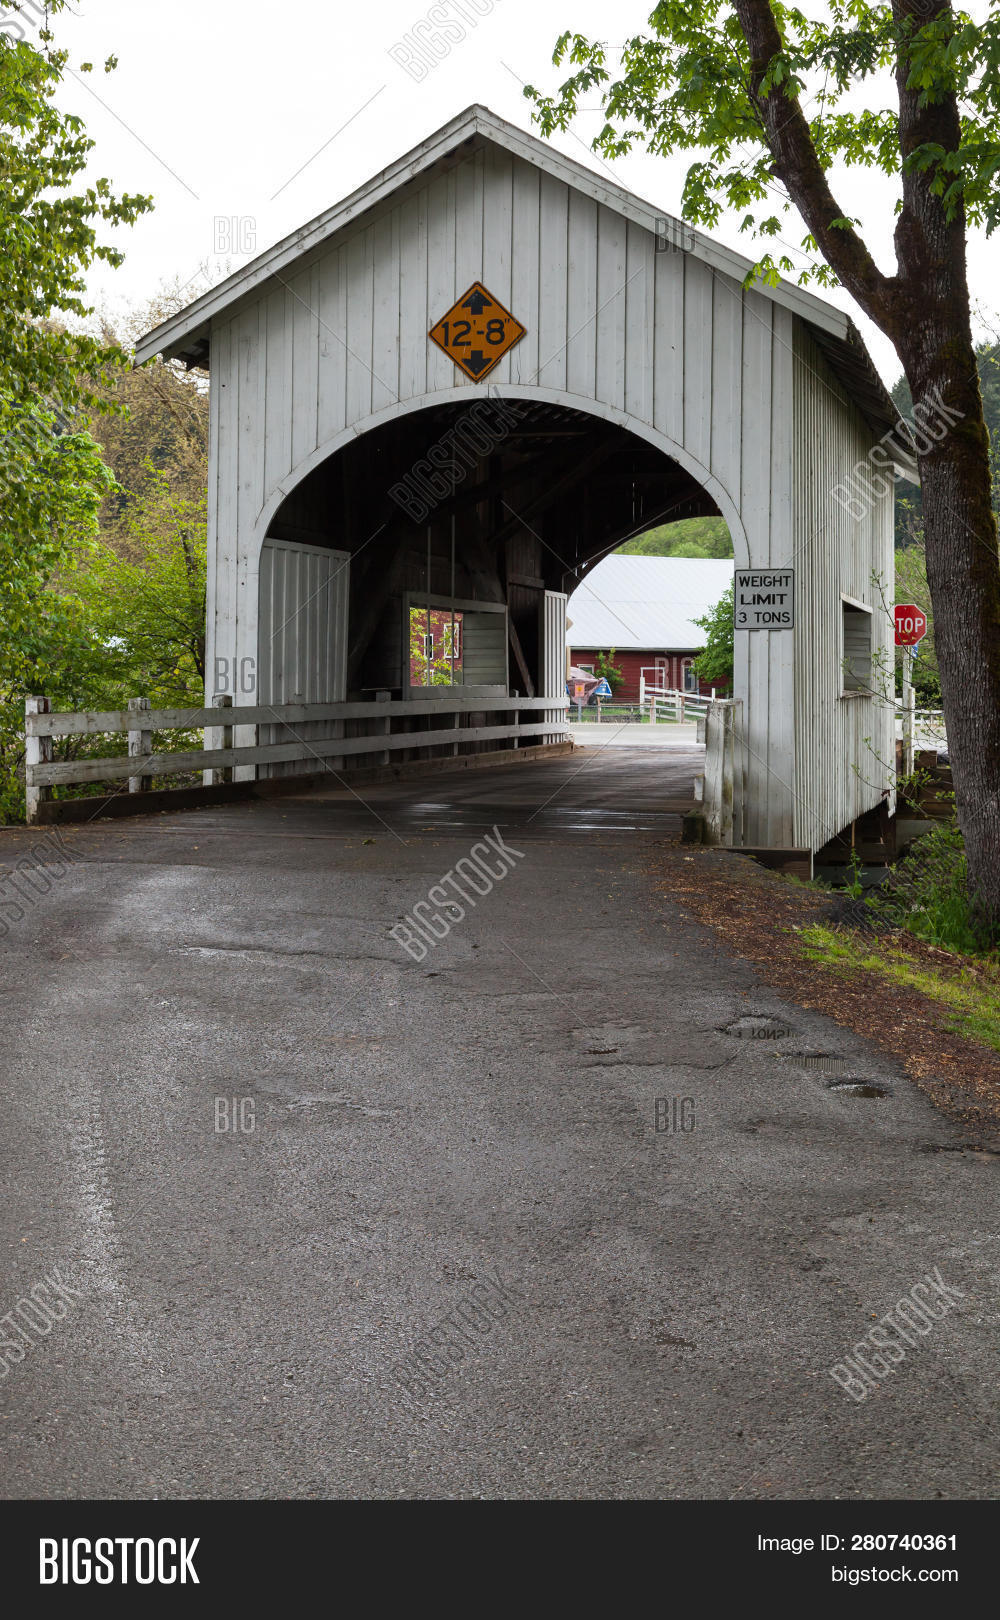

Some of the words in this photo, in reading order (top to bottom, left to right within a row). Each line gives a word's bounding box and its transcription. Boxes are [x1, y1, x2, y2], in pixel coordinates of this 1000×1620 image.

[441, 318, 511, 347] 12'-8"
[738, 575, 792, 588] WEIGHT
[740, 593, 788, 606] LIMIT
[738, 611, 748, 623] 3
[754, 611, 791, 624] TONS
[895, 617, 924, 634] TOP
